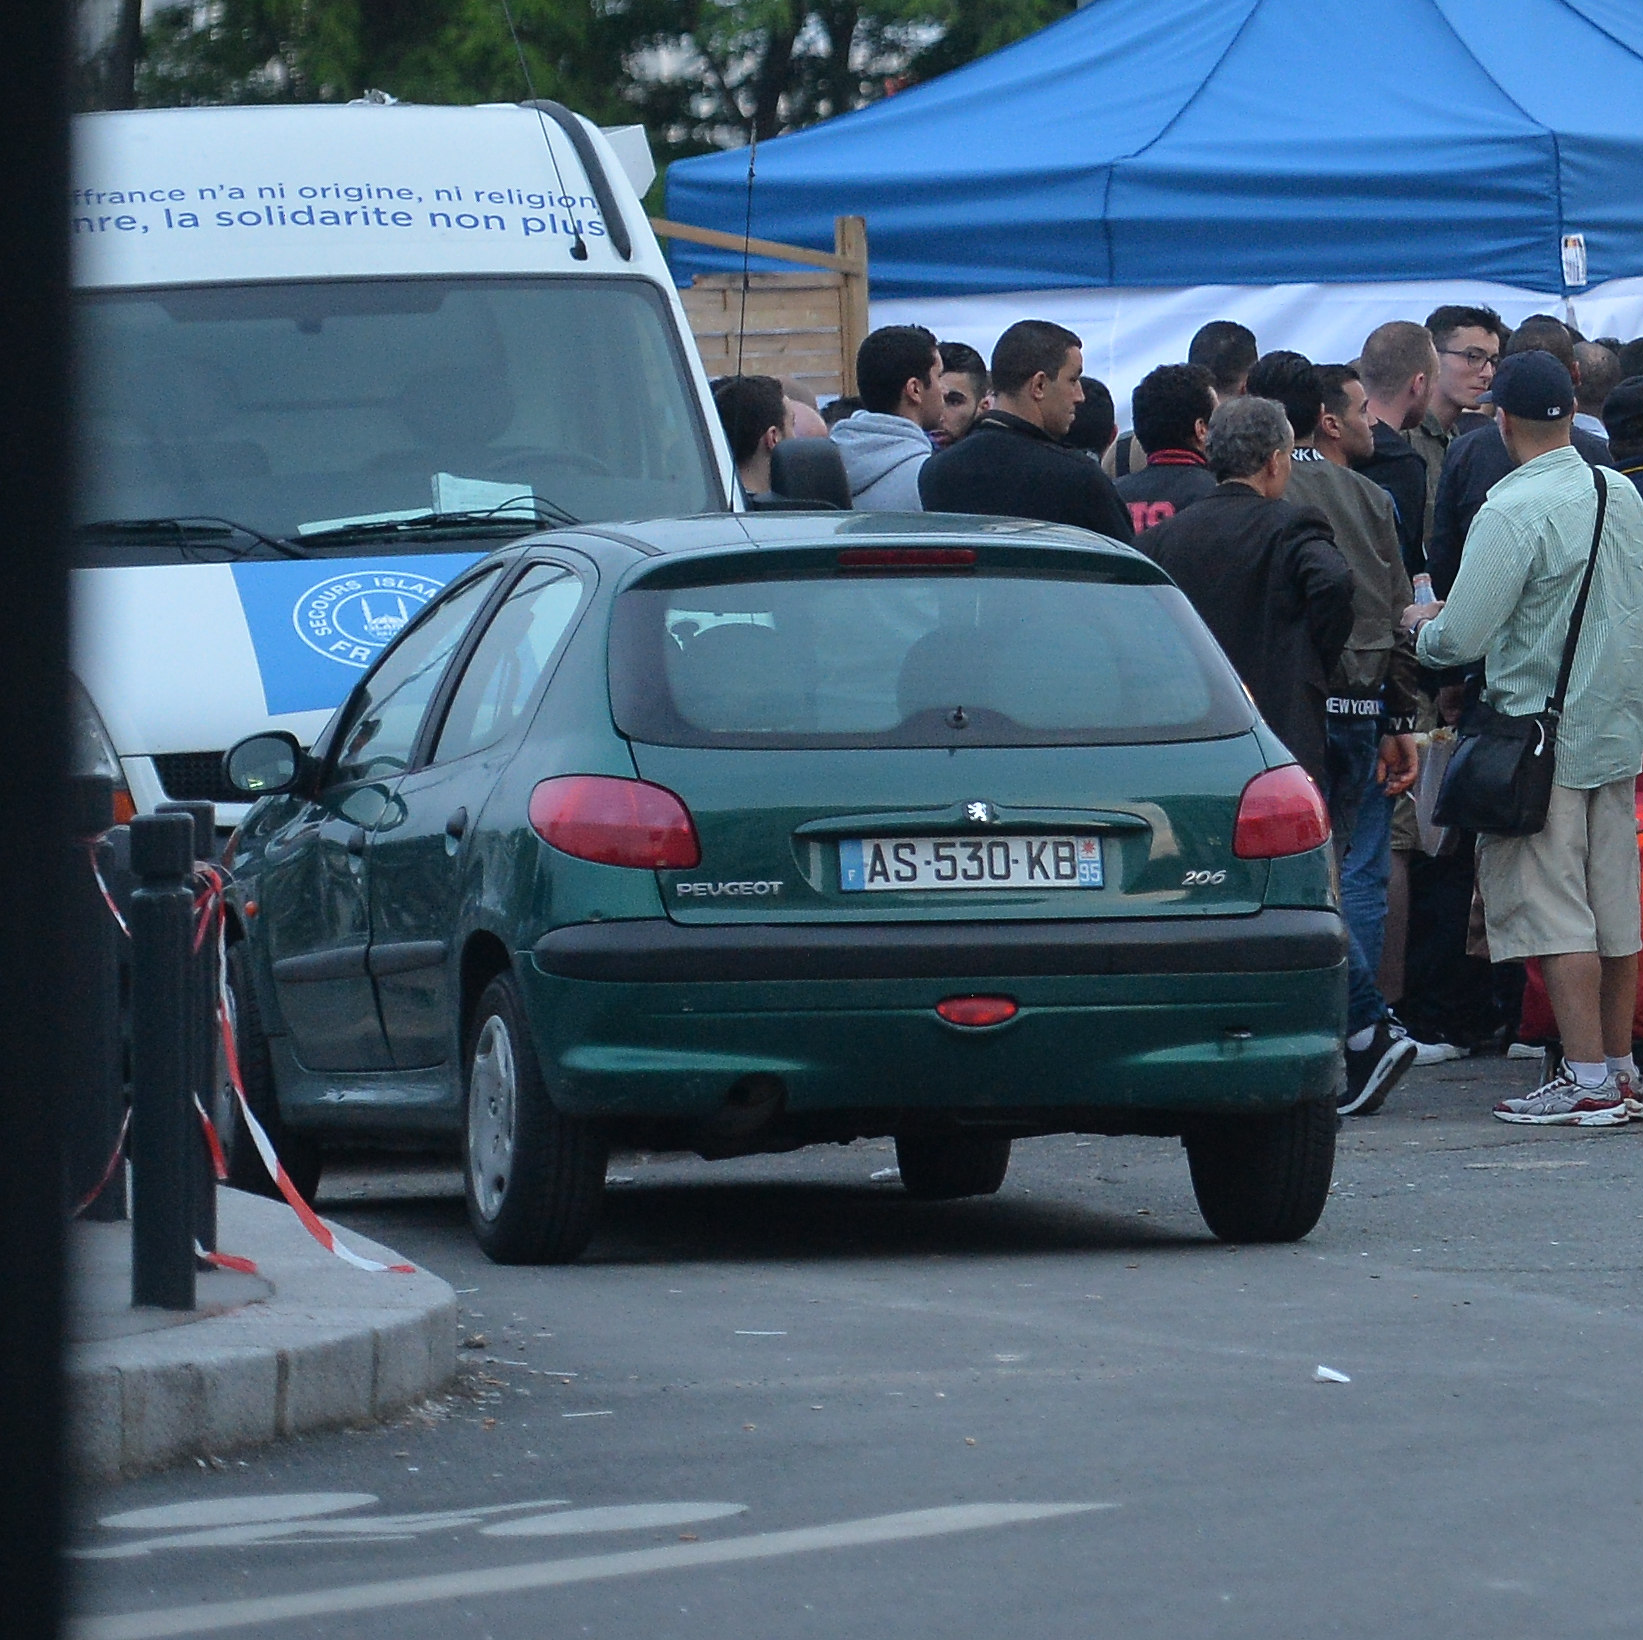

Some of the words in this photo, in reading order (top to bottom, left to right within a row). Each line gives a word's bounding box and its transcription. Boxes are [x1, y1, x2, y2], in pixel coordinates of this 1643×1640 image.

[199, 184, 246, 201] n'a
[257, 182, 286, 200] ni
[298, 182, 424, 204] origine,
[435, 185, 463, 203] ni
[164, 208, 200, 230] la
[215, 205, 413, 229] solidarite
[429, 210, 507, 231] non
[521, 212, 607, 237] plus
[307, 579, 363, 638] SECOURS
[1079, 862, 1101, 882] 95
[1181, 869, 1227, 886] 206
[676, 880, 784, 897] PEUGEOT
